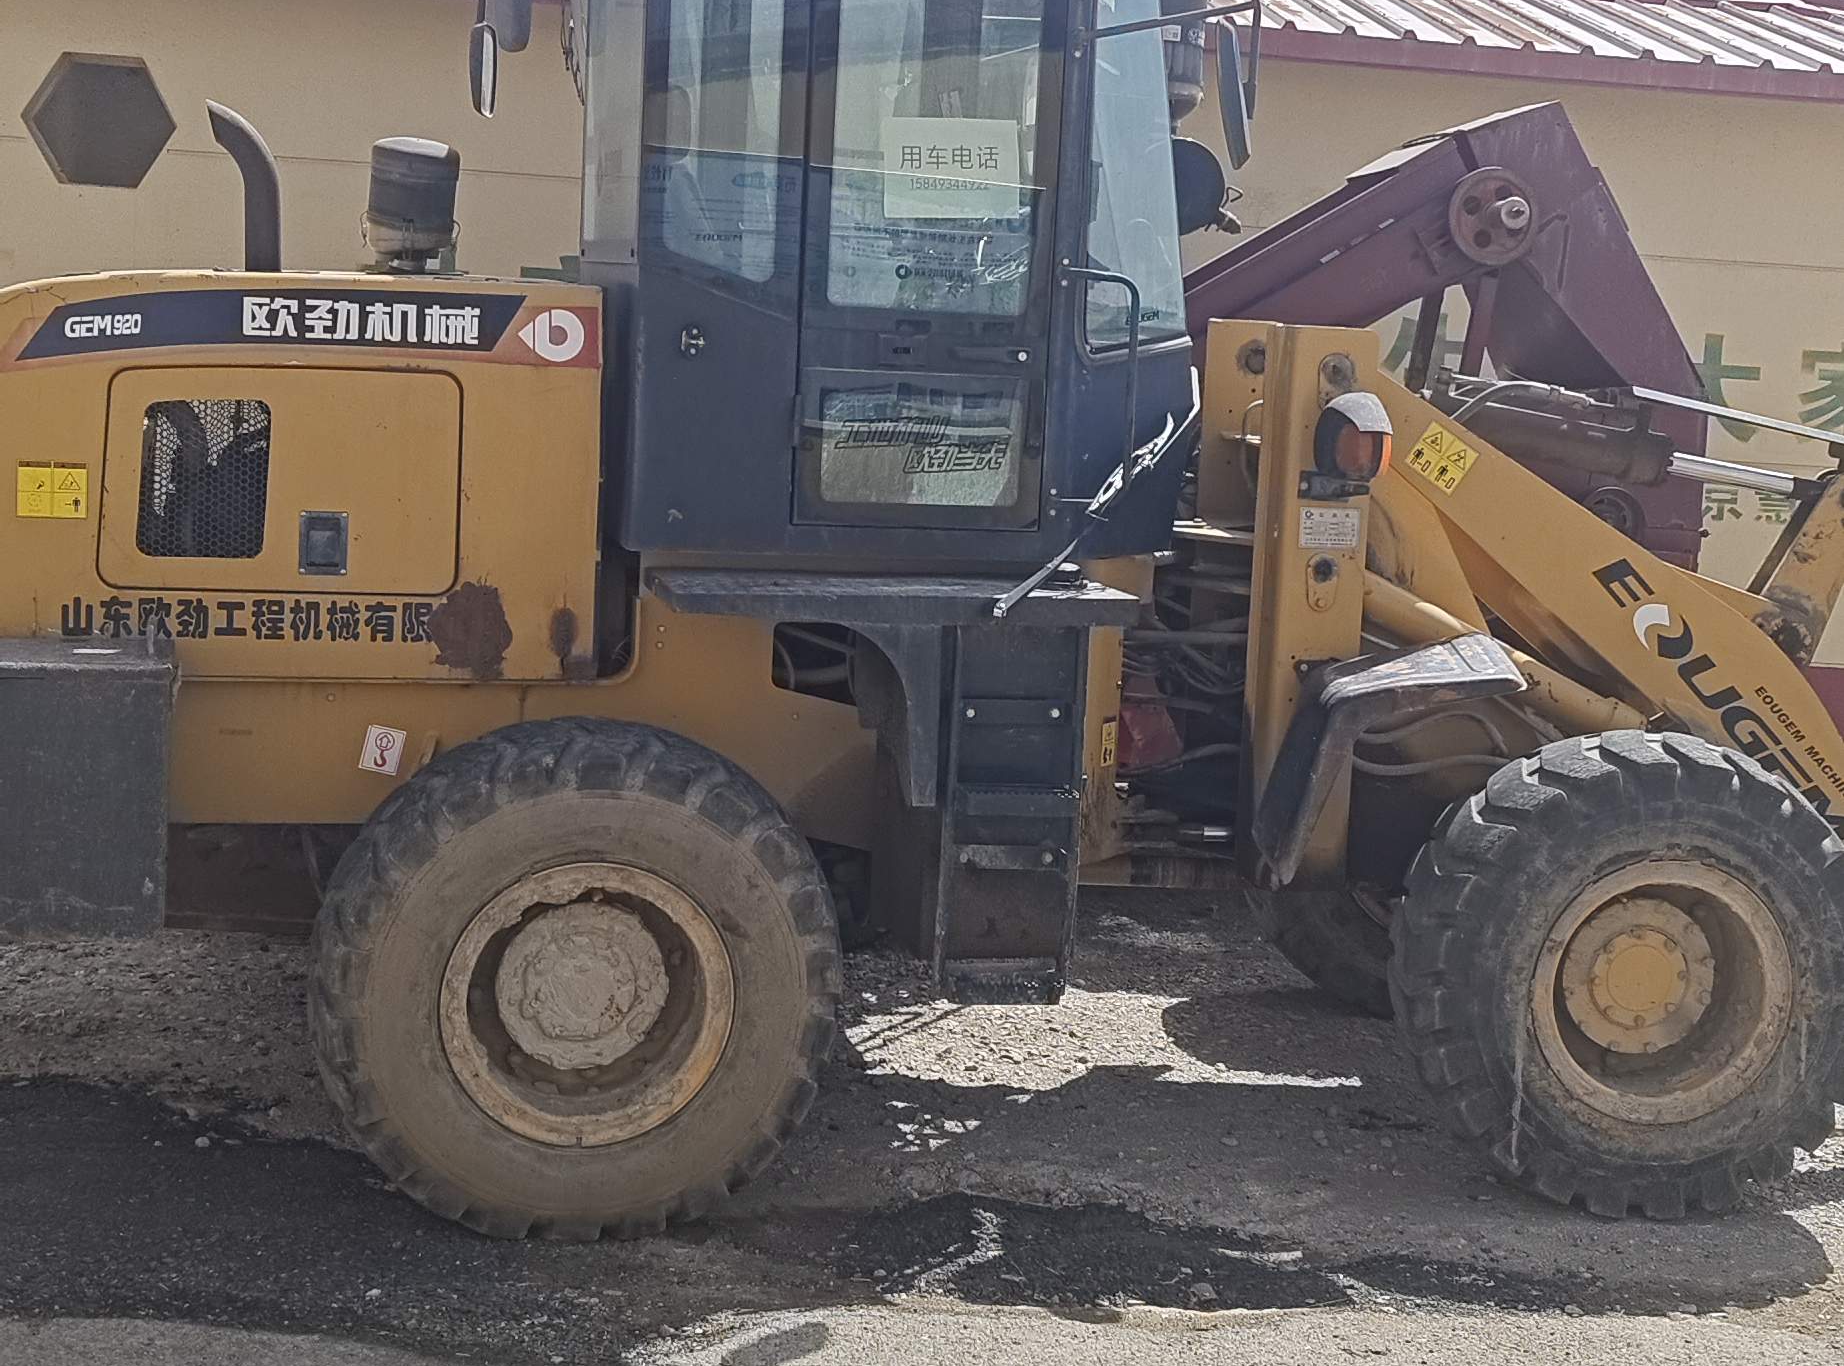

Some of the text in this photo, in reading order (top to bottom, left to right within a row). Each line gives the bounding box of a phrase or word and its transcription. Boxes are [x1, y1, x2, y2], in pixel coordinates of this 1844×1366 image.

[900, 144, 999, 170] 用车电话
[243, 296, 480, 345] 欧劲机械
[61, 596, 433, 643] 山东欧劲工程机械有限
[1755, 686, 1806, 743] EOUGEM
